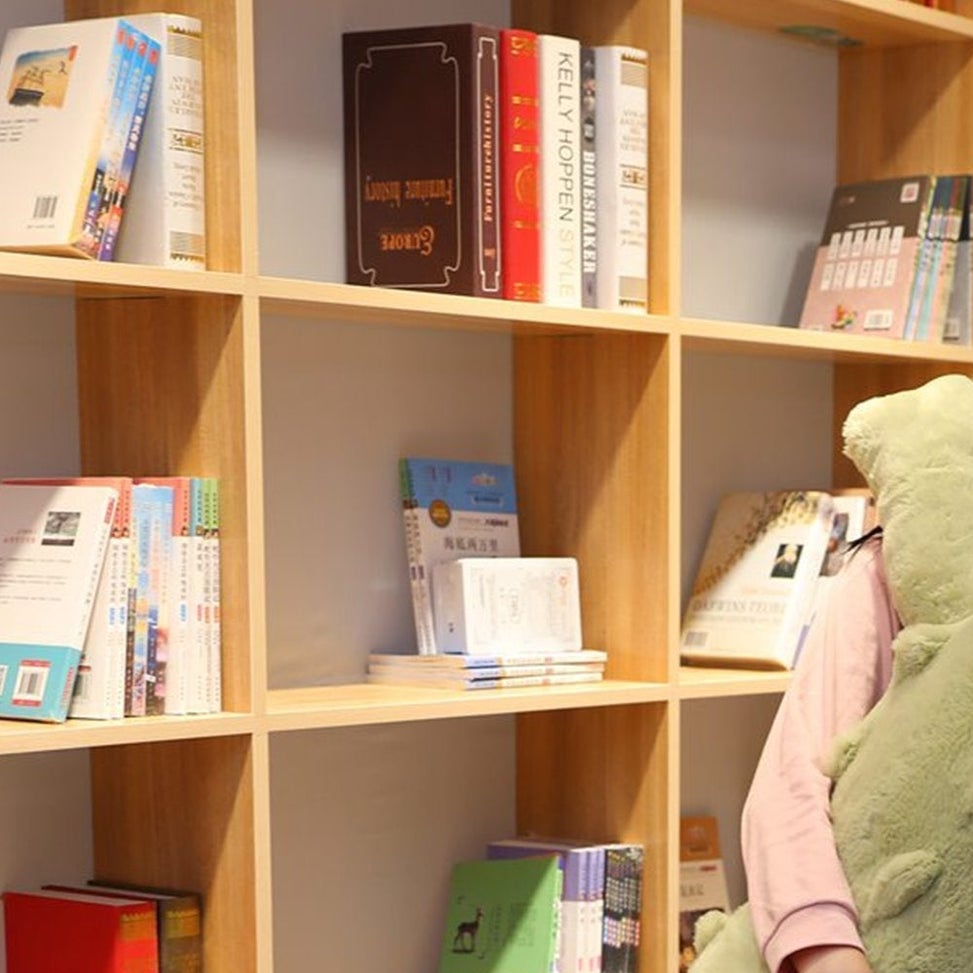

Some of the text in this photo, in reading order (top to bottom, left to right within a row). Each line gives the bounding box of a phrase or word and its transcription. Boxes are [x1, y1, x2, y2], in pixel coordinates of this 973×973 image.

[557, 51, 575, 299] KELLY HOPPEN STYLE
[582, 151, 597, 274] BONESHAKER
[442, 535, 500, 553] 海底两万里
